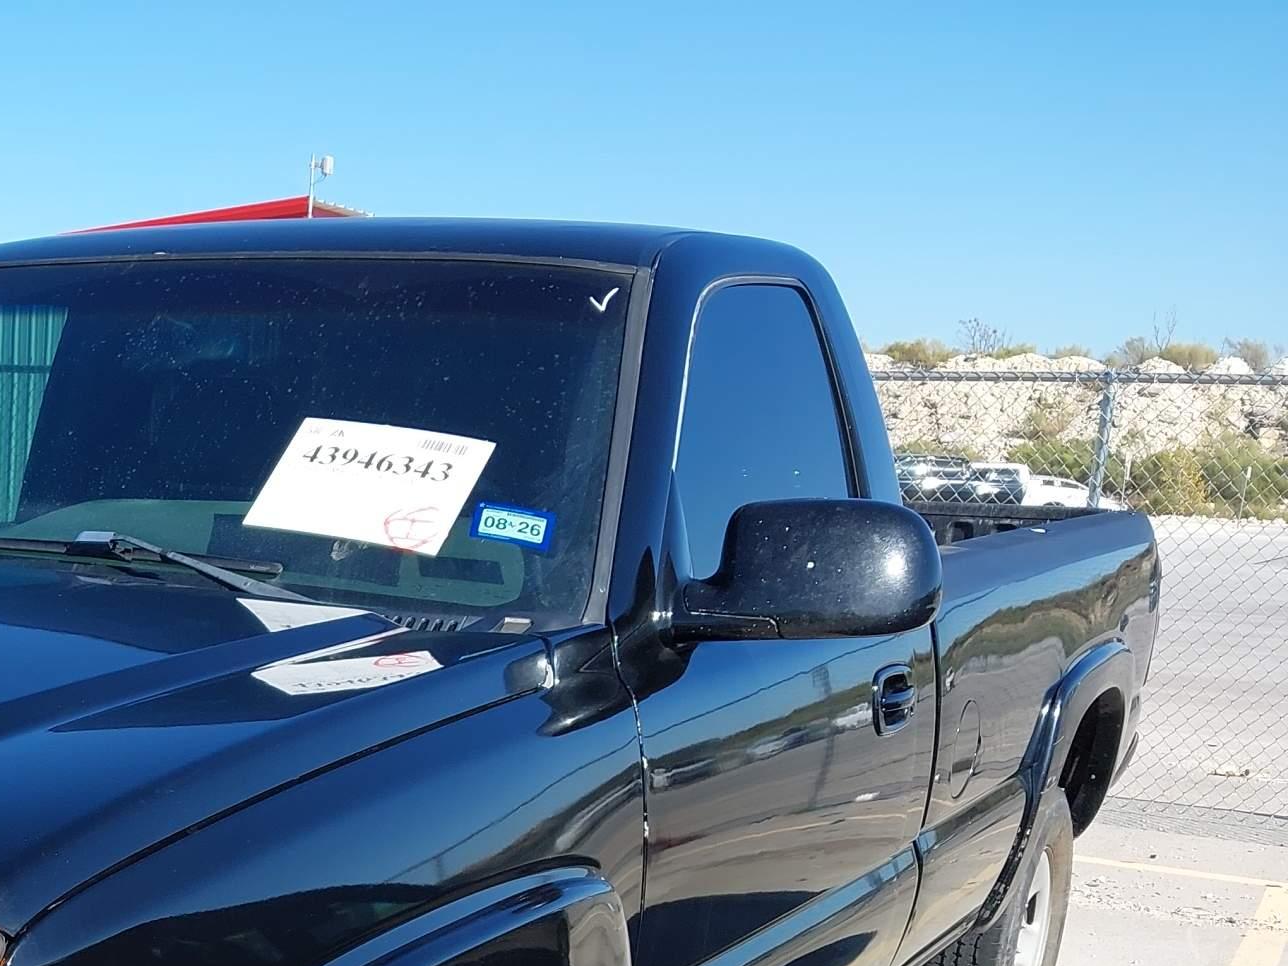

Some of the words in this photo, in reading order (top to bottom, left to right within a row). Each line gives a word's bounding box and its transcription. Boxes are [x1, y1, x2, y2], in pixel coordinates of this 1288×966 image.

[302, 444, 454, 482] 43946343
[484, 515, 508, 530] 08
[517, 521, 542, 537] 26
